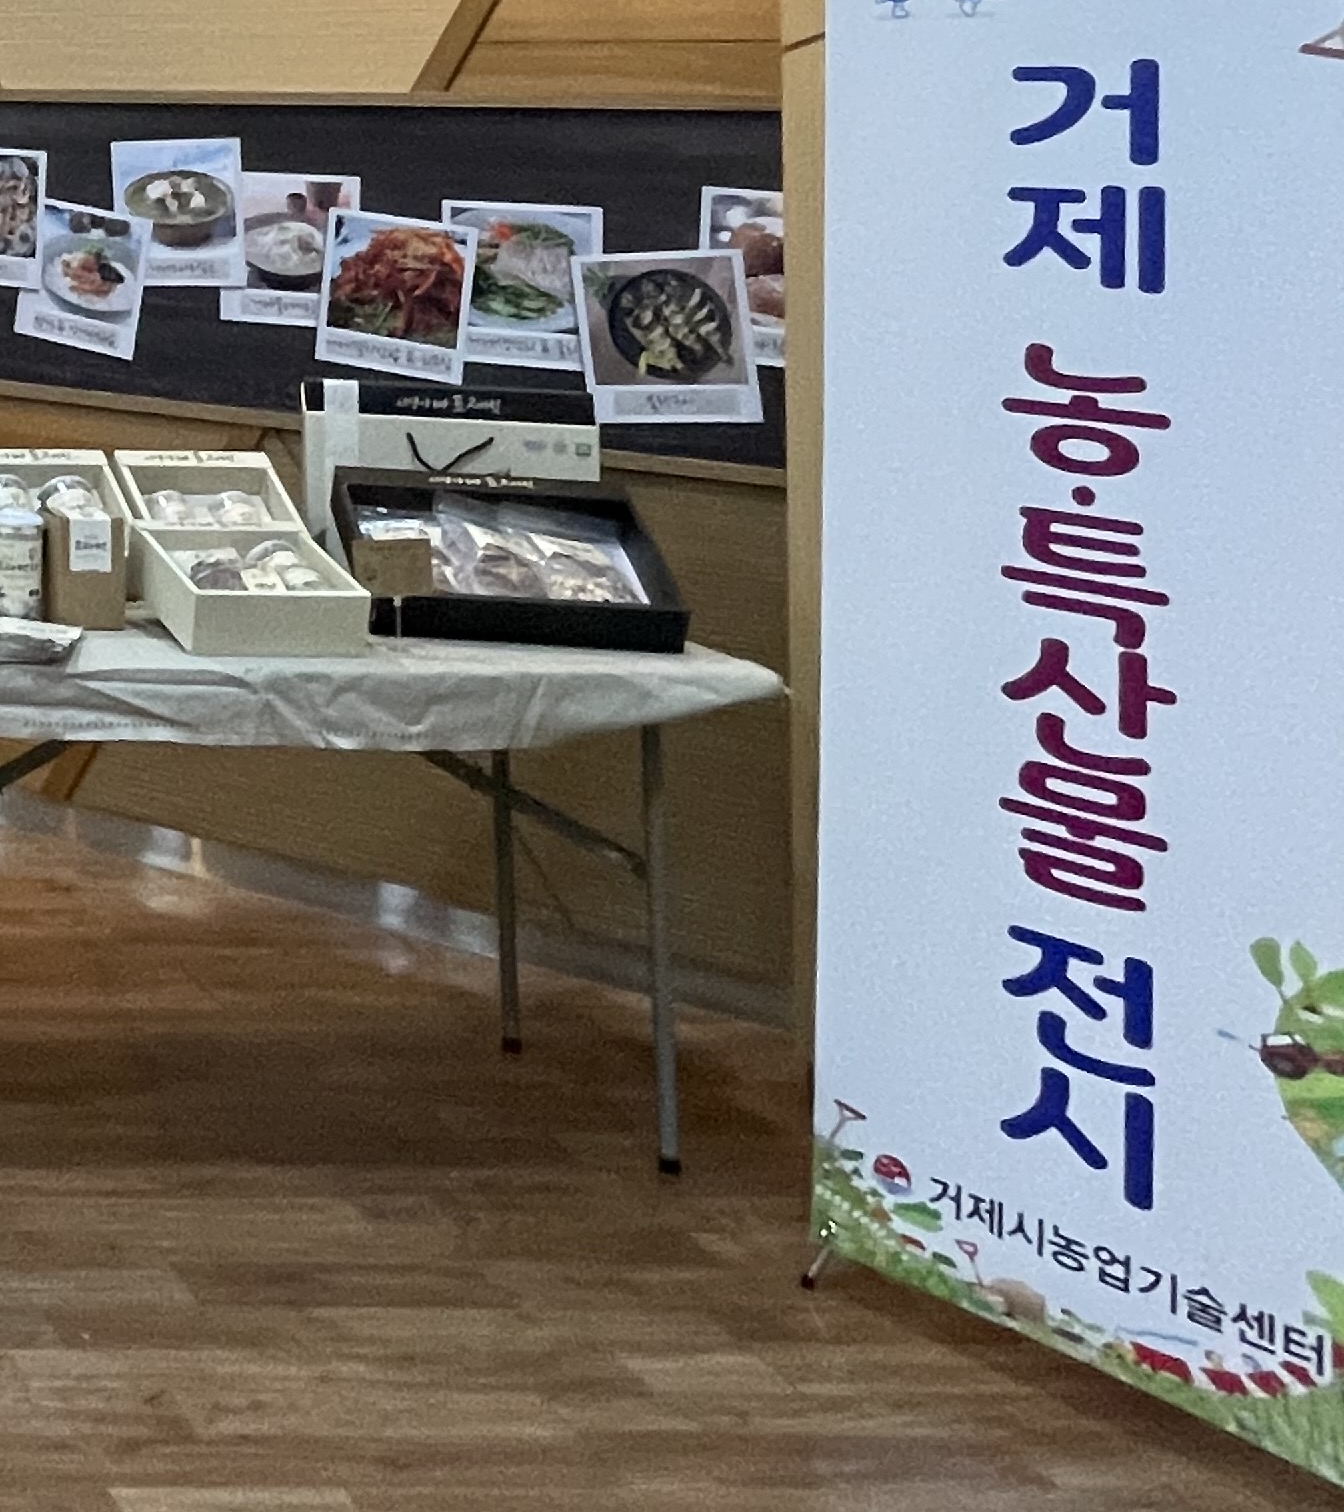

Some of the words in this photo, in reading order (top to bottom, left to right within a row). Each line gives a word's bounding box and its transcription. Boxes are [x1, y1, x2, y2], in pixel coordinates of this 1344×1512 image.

[1002, 58, 1166, 294] 거제
[999, 924, 1156, 1212] 전시
[929, 1176, 1326, 1377] 거제시농업기술센터
